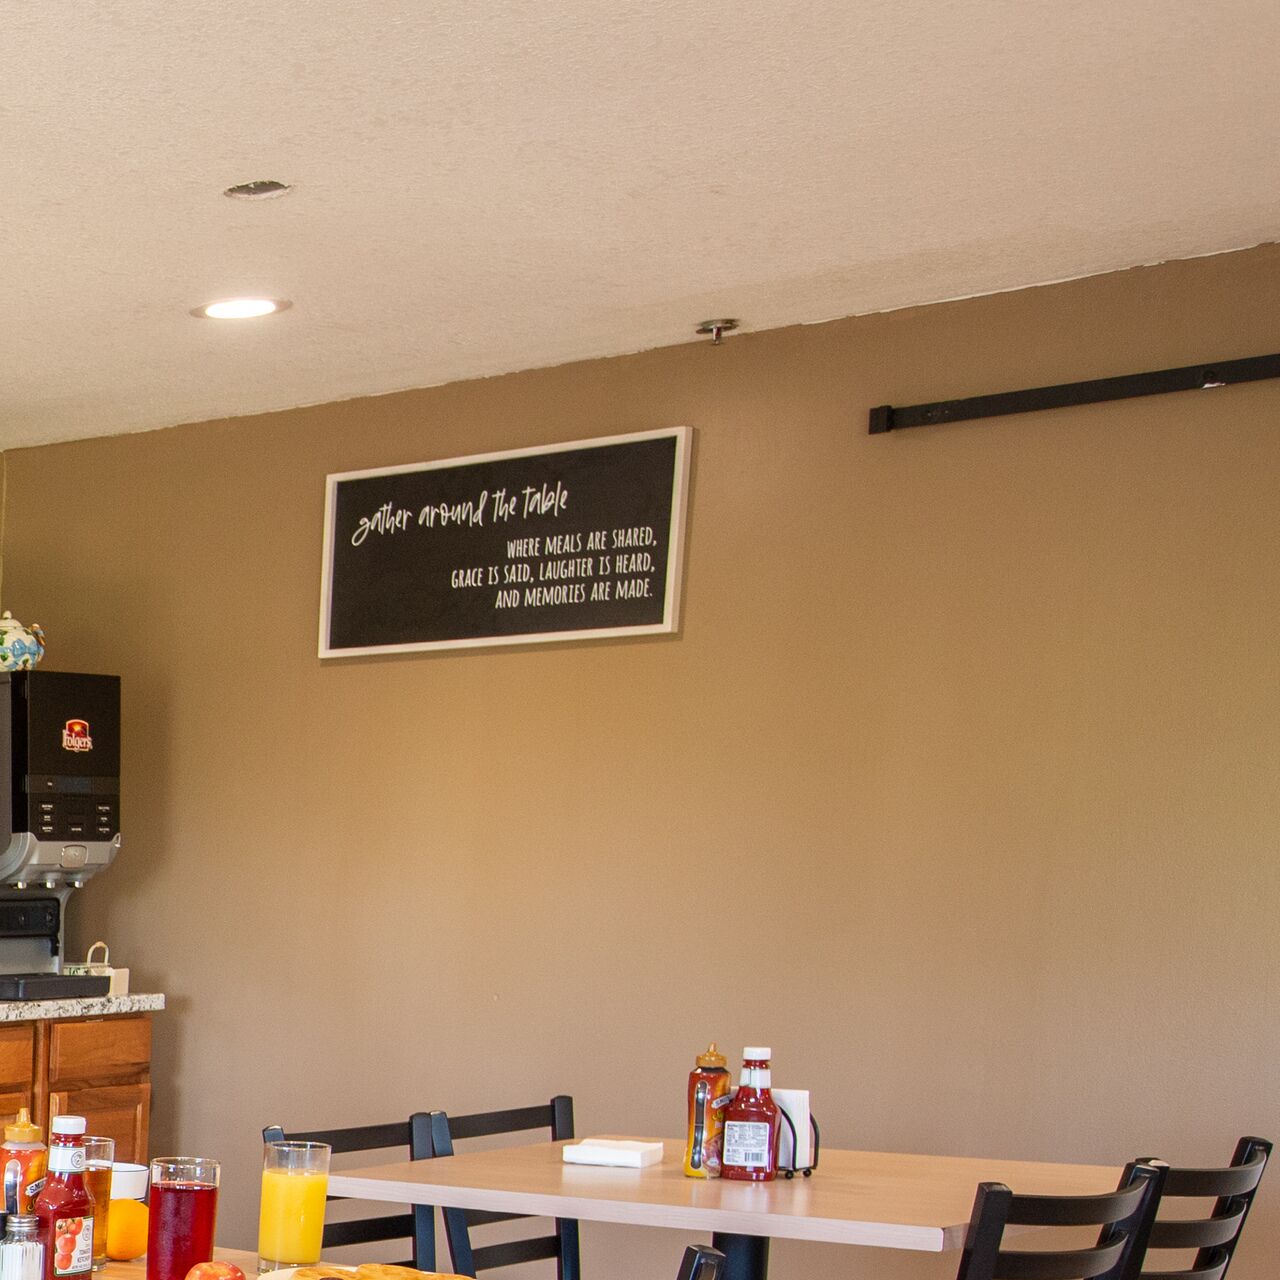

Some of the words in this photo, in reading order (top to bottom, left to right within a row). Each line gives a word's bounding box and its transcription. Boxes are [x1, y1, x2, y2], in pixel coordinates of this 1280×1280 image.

[351, 501, 413, 547] gather
[418, 490, 488, 527] around
[507, 537, 540, 559] WHERE
[544, 533, 582, 556] MEALS
[586, 531, 608, 550] ARE
[612, 526, 658, 550] SHARED,
[451, 567, 483, 589] GRACE
[487, 566, 499, 585] IS
[503, 563, 534, 585] SAID,
[539, 556, 593, 581] LAUGHTER
[599, 555, 611, 575] IS
[615, 552, 656, 574] HEARD,
[495, 589, 520, 609] AND
[524, 584, 586, 607] MEMORIES
[590, 581, 611, 601] ARE
[615, 578, 653, 600] MADE.
